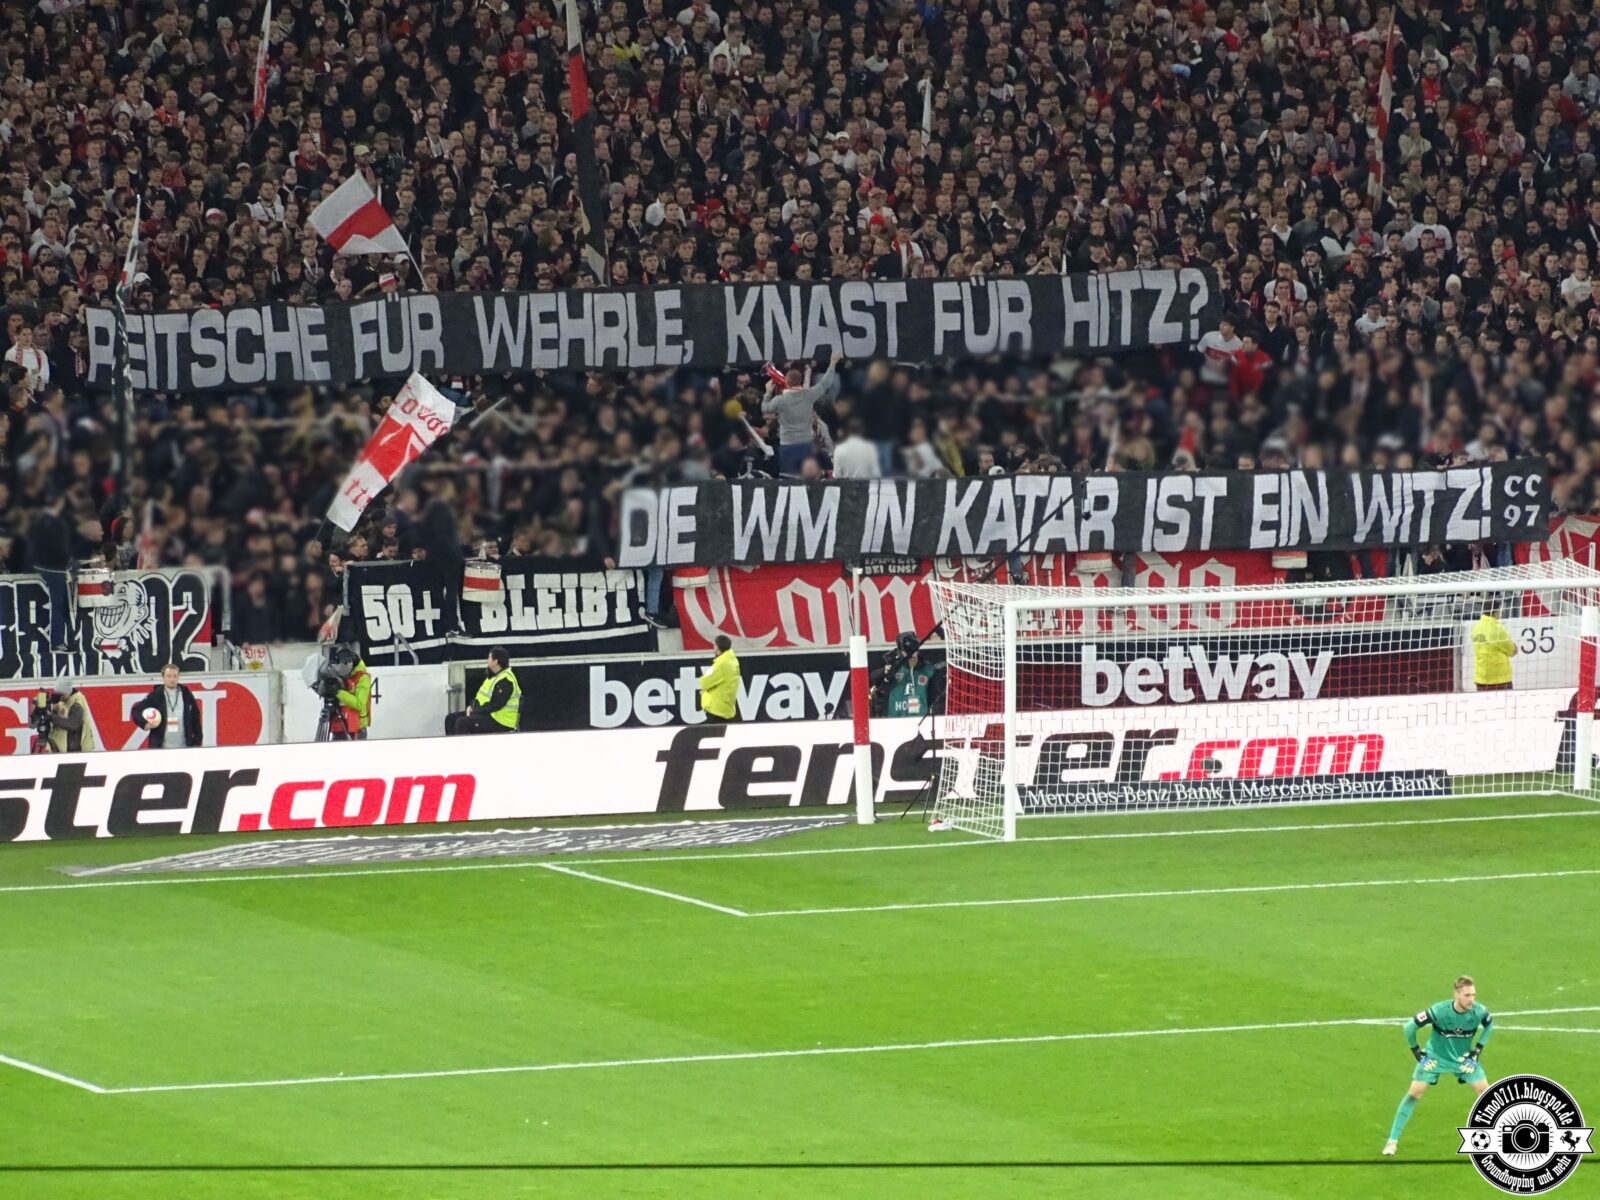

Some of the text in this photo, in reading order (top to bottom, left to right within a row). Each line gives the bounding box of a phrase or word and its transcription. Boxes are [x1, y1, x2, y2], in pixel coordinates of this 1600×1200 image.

[86, 268, 1210, 391] PEITSCHE FÜR WEHRLE, KNAST FÜR HITZ?
[1503, 473, 1543, 498] CC
[620, 466, 1493, 568] DIE WM IN KATAR IST EIN WITZ!
[1503, 504, 1541, 528] 97
[864, 565, 884, 575] BEI
[1520, 626, 1556, 655] 35
[1080, 643, 1334, 707] betway
[1174, 783, 1225, 801] Bank
[1239, 775, 1444, 798] Mercedes-Benz Bank
